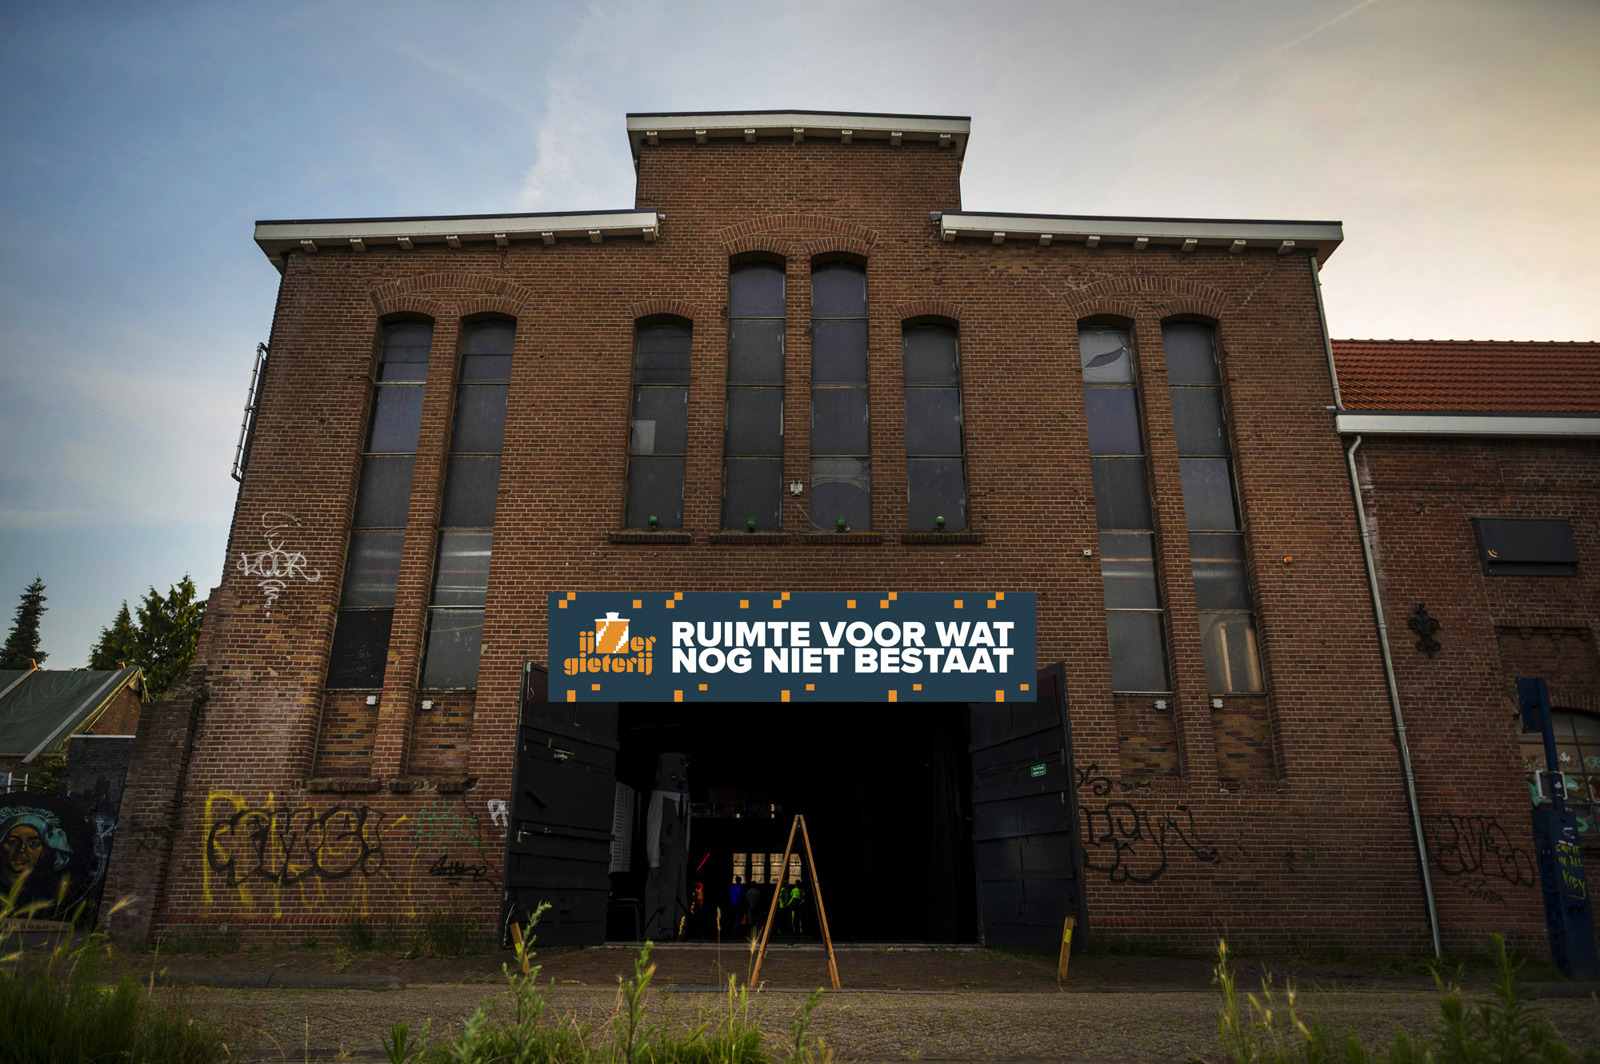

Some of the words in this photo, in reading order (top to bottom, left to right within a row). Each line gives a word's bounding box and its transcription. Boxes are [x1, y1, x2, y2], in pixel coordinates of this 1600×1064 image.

[672, 621, 811, 647] RUIMTE
[819, 621, 925, 647] VOOR
[934, 621, 1014, 647] WAT
[563, 652, 653, 676] gieterij
[672, 647, 752, 673] NOG
[763, 647, 844, 673] NIET
[854, 647, 1014, 673] BESTAAT
